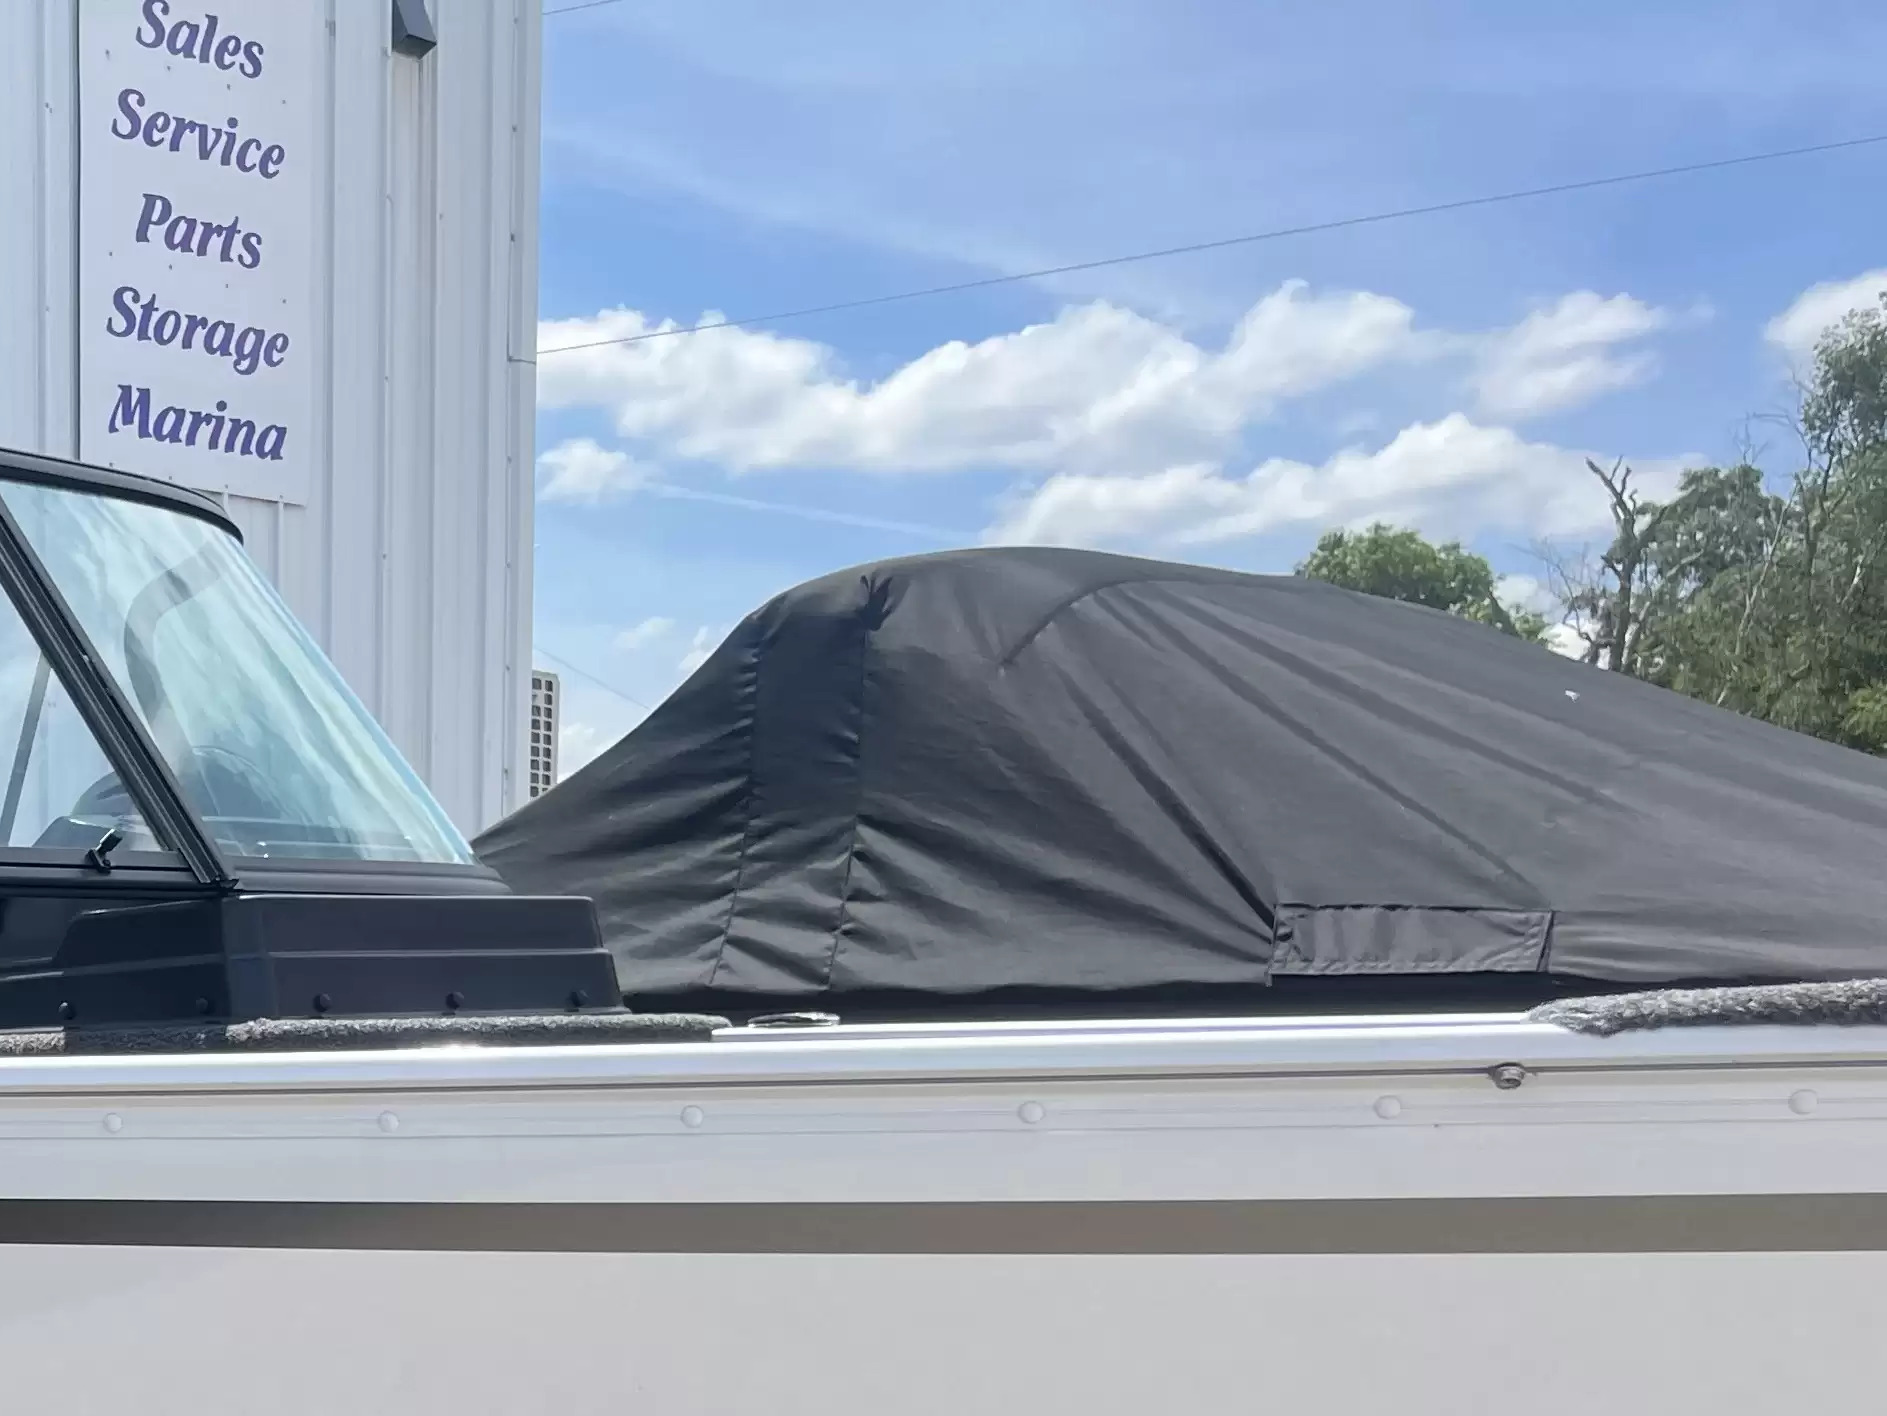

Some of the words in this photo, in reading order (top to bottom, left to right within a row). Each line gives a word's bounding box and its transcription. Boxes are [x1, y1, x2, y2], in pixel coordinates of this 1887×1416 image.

[136, 0, 265, 78] Sales
[112, 88, 285, 179] Service
[135, 193, 262, 269] Parts
[107, 286, 289, 375] Storage
[108, 384, 287, 460] Marina
